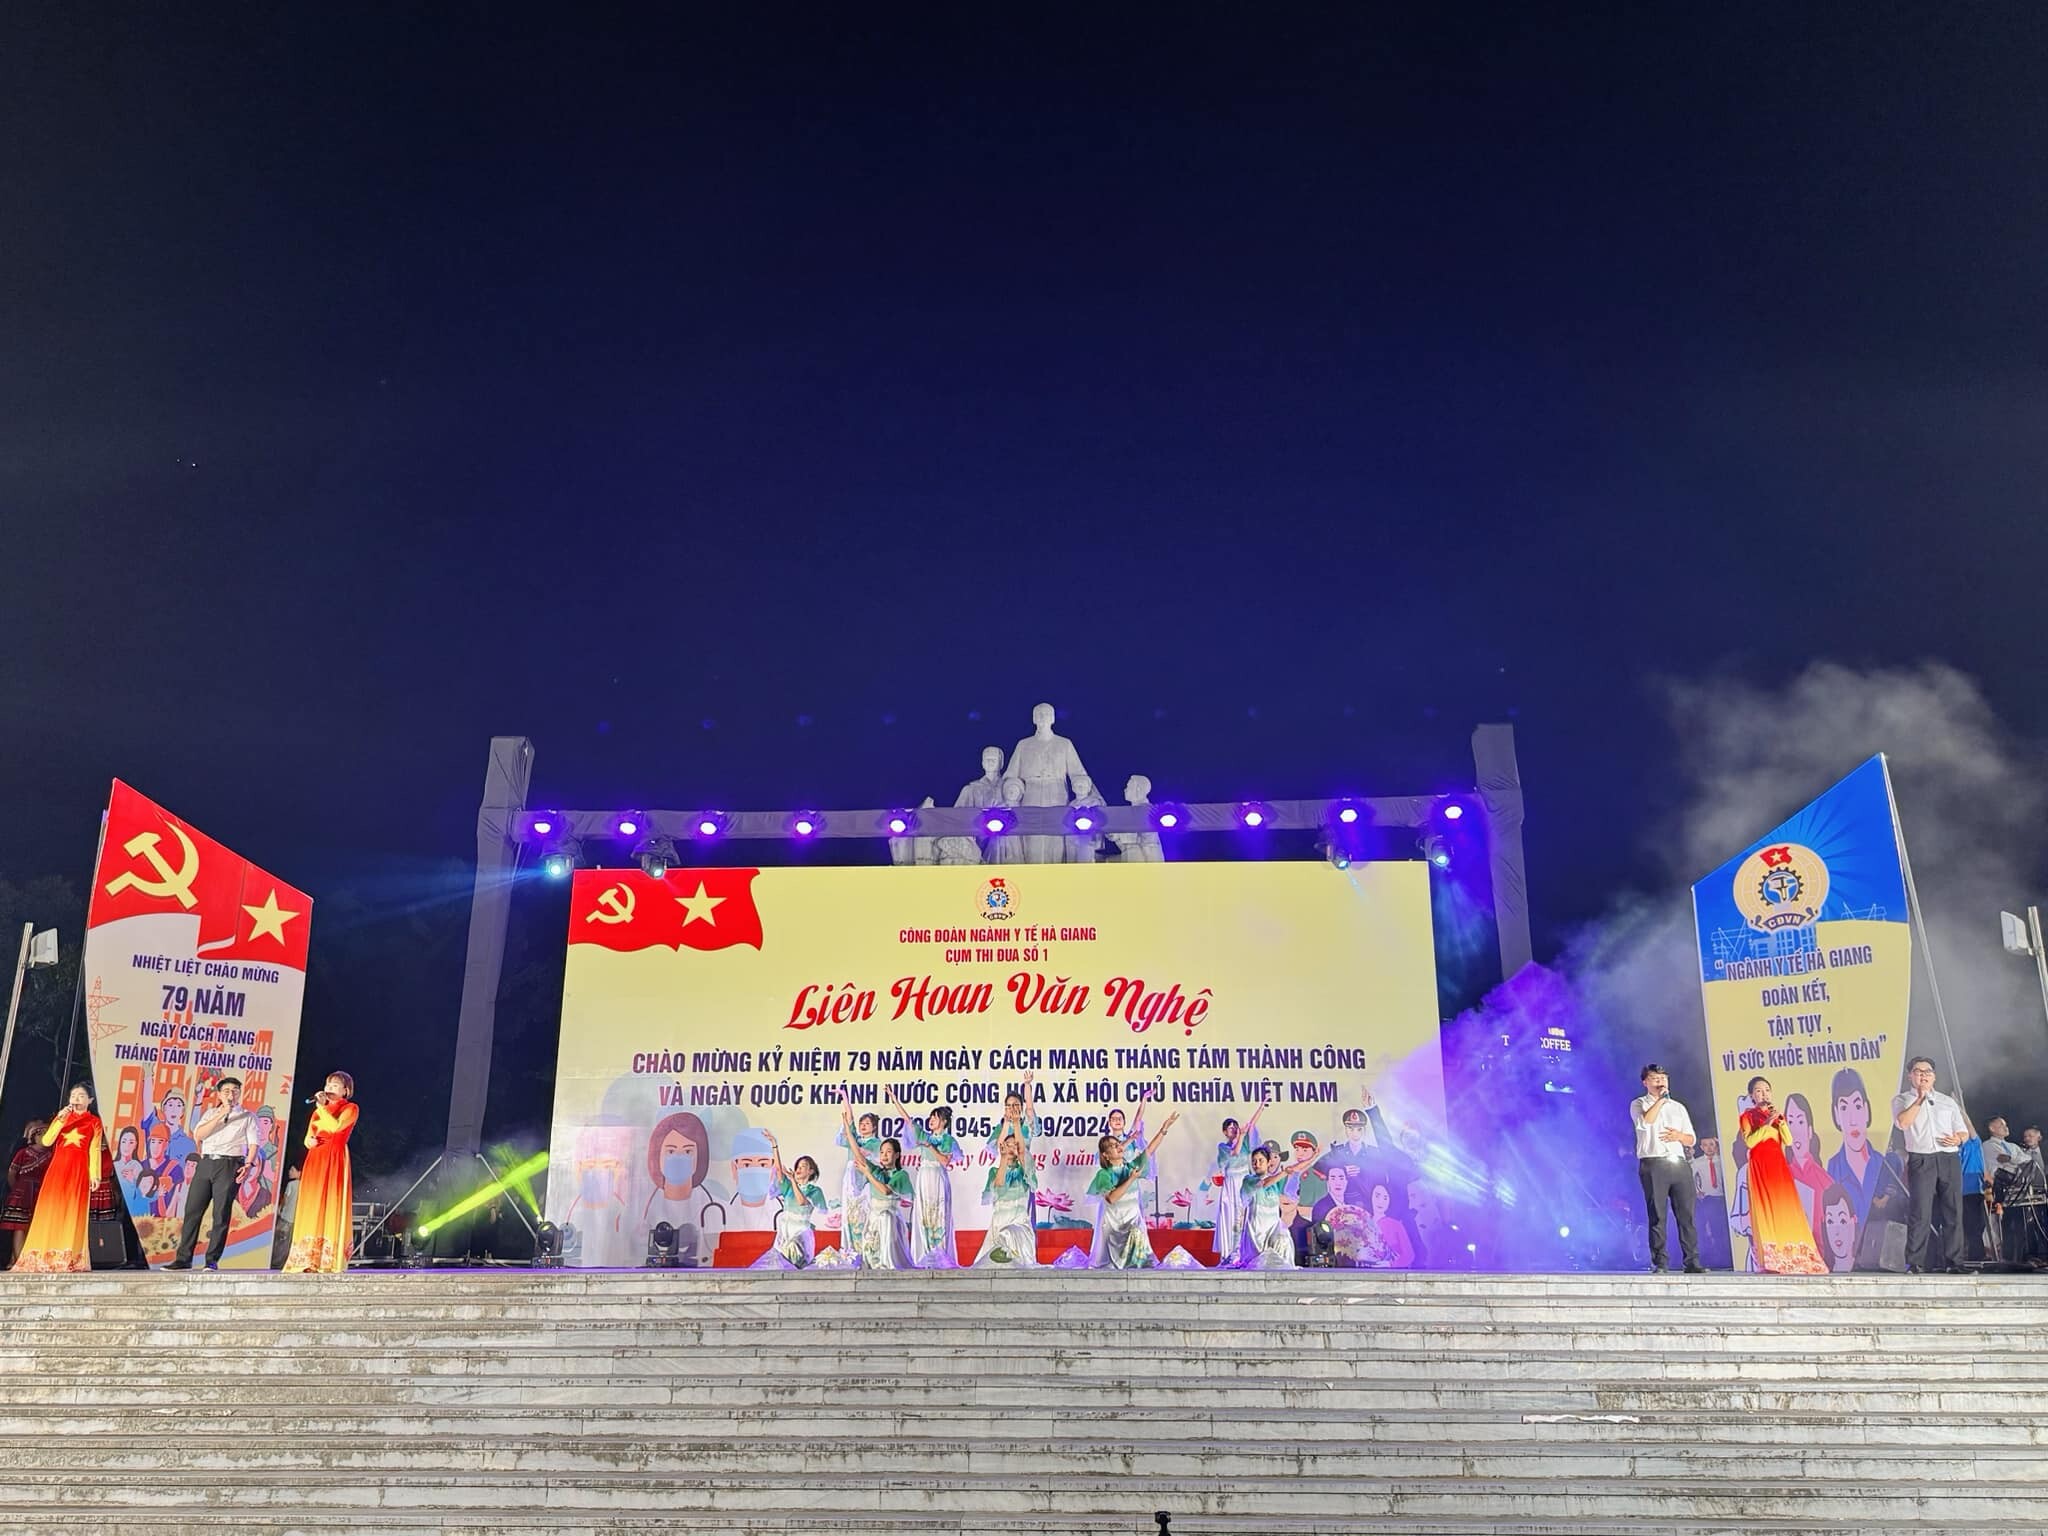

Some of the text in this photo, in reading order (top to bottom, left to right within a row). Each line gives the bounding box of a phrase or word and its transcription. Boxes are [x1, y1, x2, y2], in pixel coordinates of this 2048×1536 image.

[899, 923, 1096, 943] CÔNG ĐOÀN NGÀNH Y TẾ HÀ GIANG
[132, 954, 279, 984] NHIỆT LIỆT CHÀO MỪNG
[945, 943, 1048, 966] CỤM THI ĐUA SỐ 1
[1775, 957, 1785, 975] Y
[1787, 949, 1804, 972] TẾ
[1807, 948, 1826, 971] HÀ
[1829, 945, 1873, 968] GIANG
[162, 984, 246, 1017] 79 NĂM
[782, 972, 1214, 1036] Liên Hoan Văn Nghệ
[1761, 978, 1830, 1007] ĐOÀN KẾT,
[140, 1021, 255, 1047] NGÀY CÁCH MẠNG
[1767, 1015, 1794, 1040] TẬN
[115, 1043, 273, 1071] THÁNG TÁM THÀNH CÔNG
[632, 1044, 1366, 1076] CHÀO MỪNG KỶ NIỆM 79 NĂM NGÀY CÁCH MẠNG THÁNG TÁM THÀNH CÔNG
[1723, 1050, 1736, 1071] VÌ
[1739, 1048, 1765, 1070] SỨC
[1807, 1041, 1847, 1064] NHÂN
[659, 1081, 684, 1106] VÀ
[690, 1081, 744, 1106] NGÀY
[750, 1077, 803, 1107] QUỐC
[810, 1080, 878, 1104] KHÁNH
[945, 1079, 1000, 1108] CỘNG
[1053, 1079, 1079, 1103] XÃ
[1086, 1078, 1118, 1107] HỘI
[1125, 1075, 1166, 1102] CHỦ
[1172, 1078, 1234, 1102] NGHĨA
[1241, 1077, 1283, 1107] VIỆT
[1290, 1082, 1338, 1102] NAM
[1051, 1149, 1061, 1166] 8
